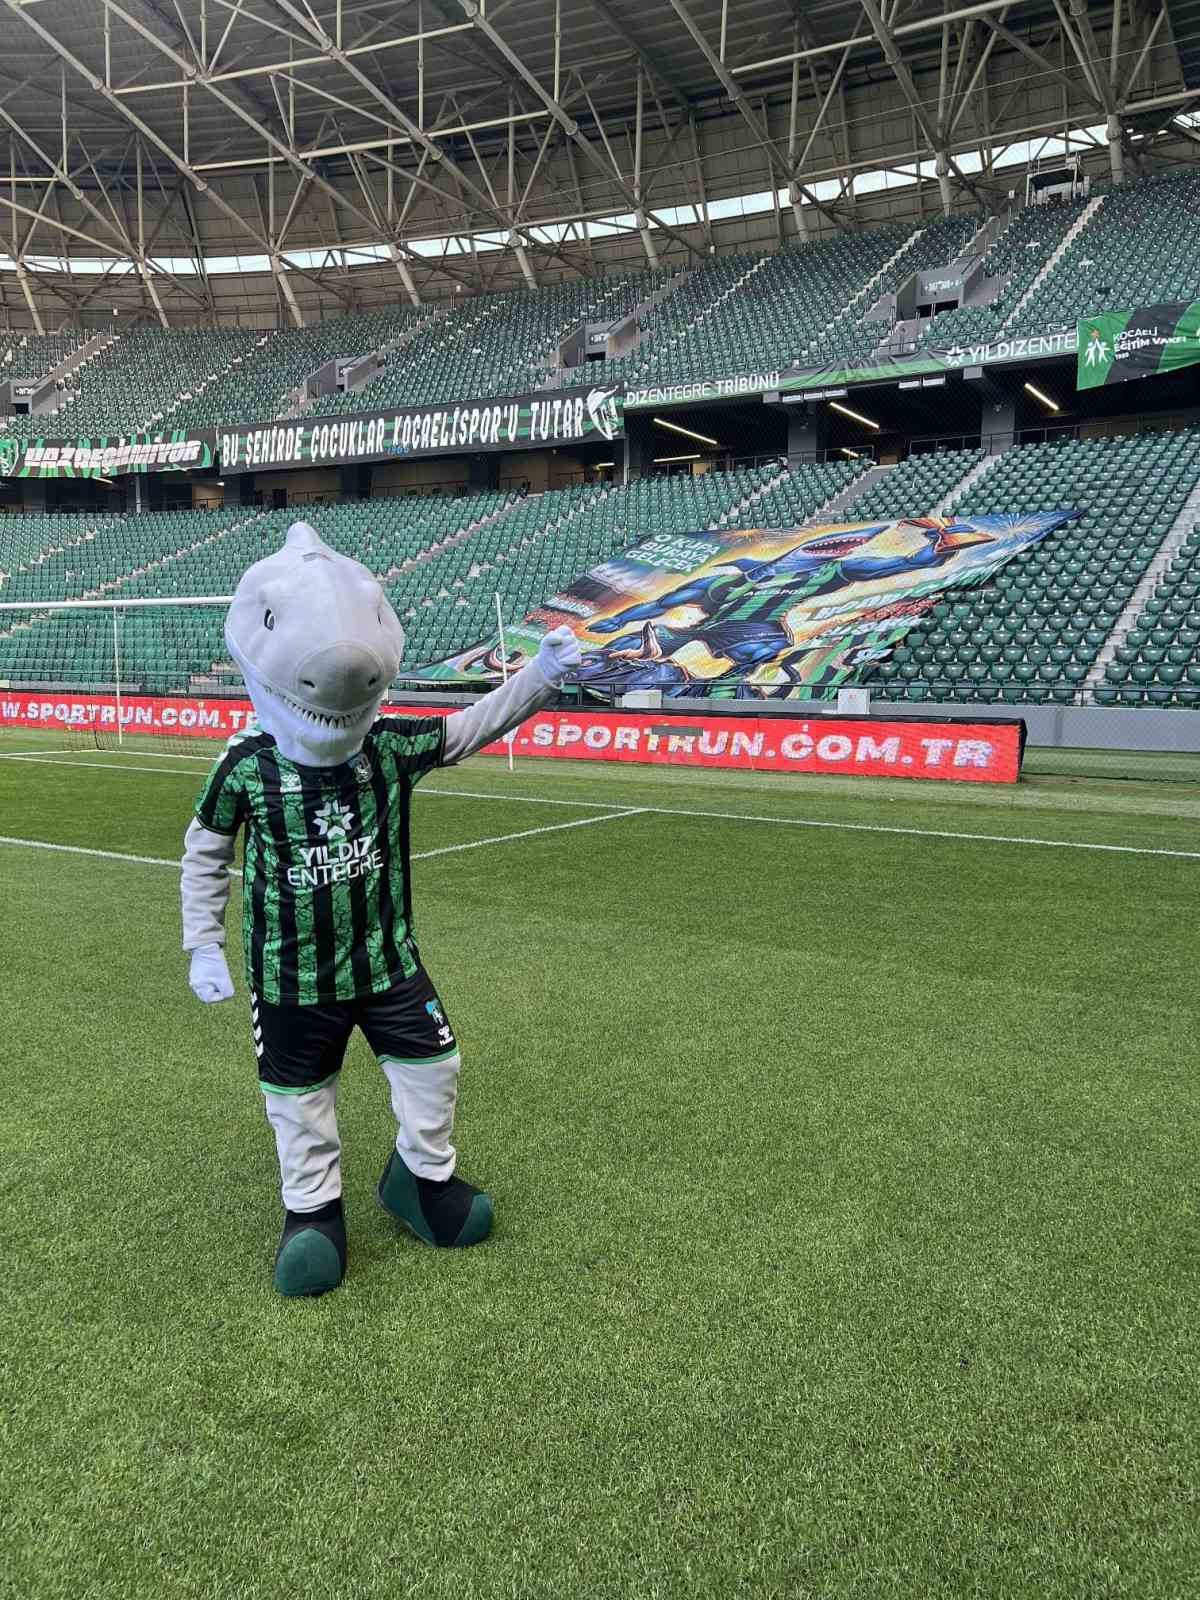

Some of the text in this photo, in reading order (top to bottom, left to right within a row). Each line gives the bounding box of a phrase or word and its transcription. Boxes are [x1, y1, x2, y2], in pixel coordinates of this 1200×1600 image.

[1113, 327, 1158, 342] KOCAELİ
[715, 371, 780, 394] TRİBÜNÜ
[223, 397, 584, 468] BU ŞEHİRDE ÇOCUKLAR KOCAELİSPOR'U TUTAR
[654, 534, 720, 555] O KUPA
[299, 836, 372, 867] YILDIZ
[287, 849, 385, 886] ENTEGRE
